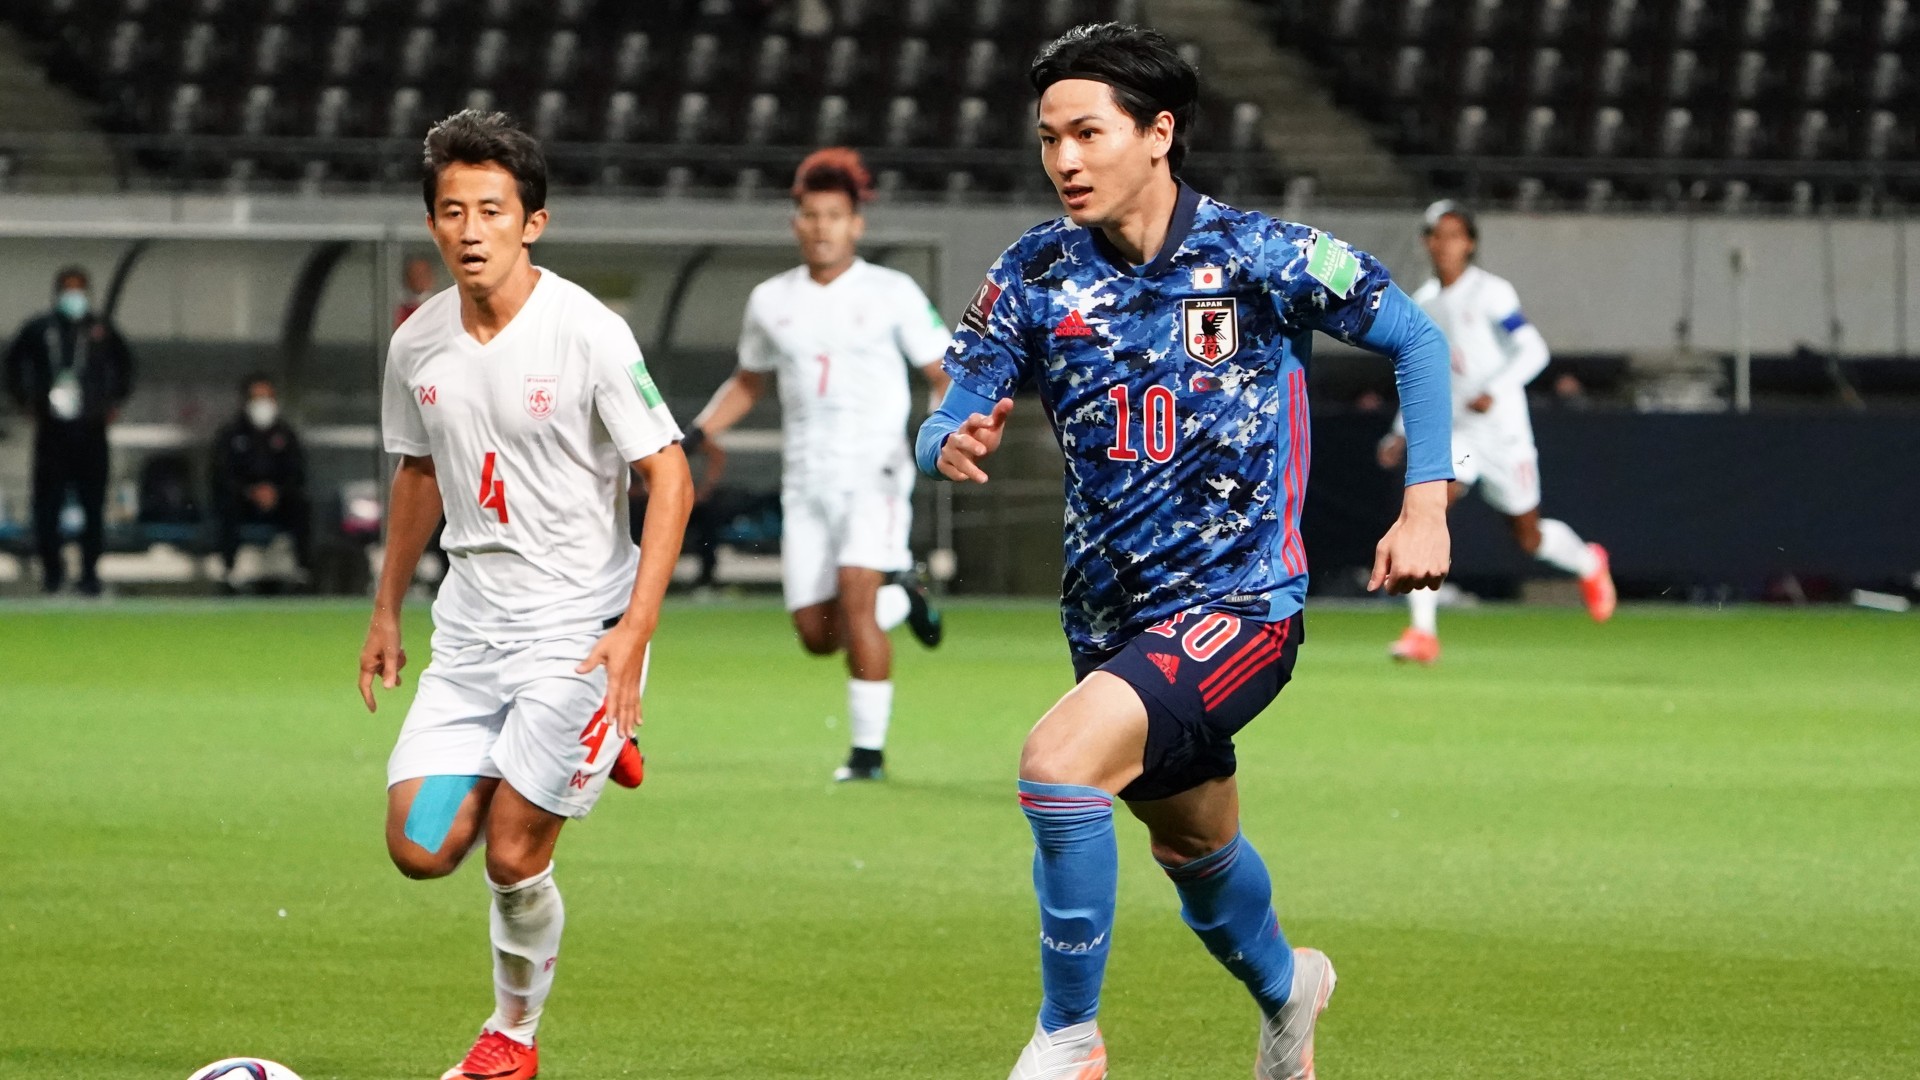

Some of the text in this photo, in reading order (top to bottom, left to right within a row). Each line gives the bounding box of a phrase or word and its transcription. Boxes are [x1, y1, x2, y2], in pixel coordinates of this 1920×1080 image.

[1195, 300, 1223, 308] JAPAN
[1054, 326, 1093, 337] adidas
[1199, 344, 1223, 355] JFA
[814, 353, 831, 398] 7
[1107, 384, 1176, 463] 10
[478, 452, 509, 524] 4
[578, 695, 609, 765] 4
